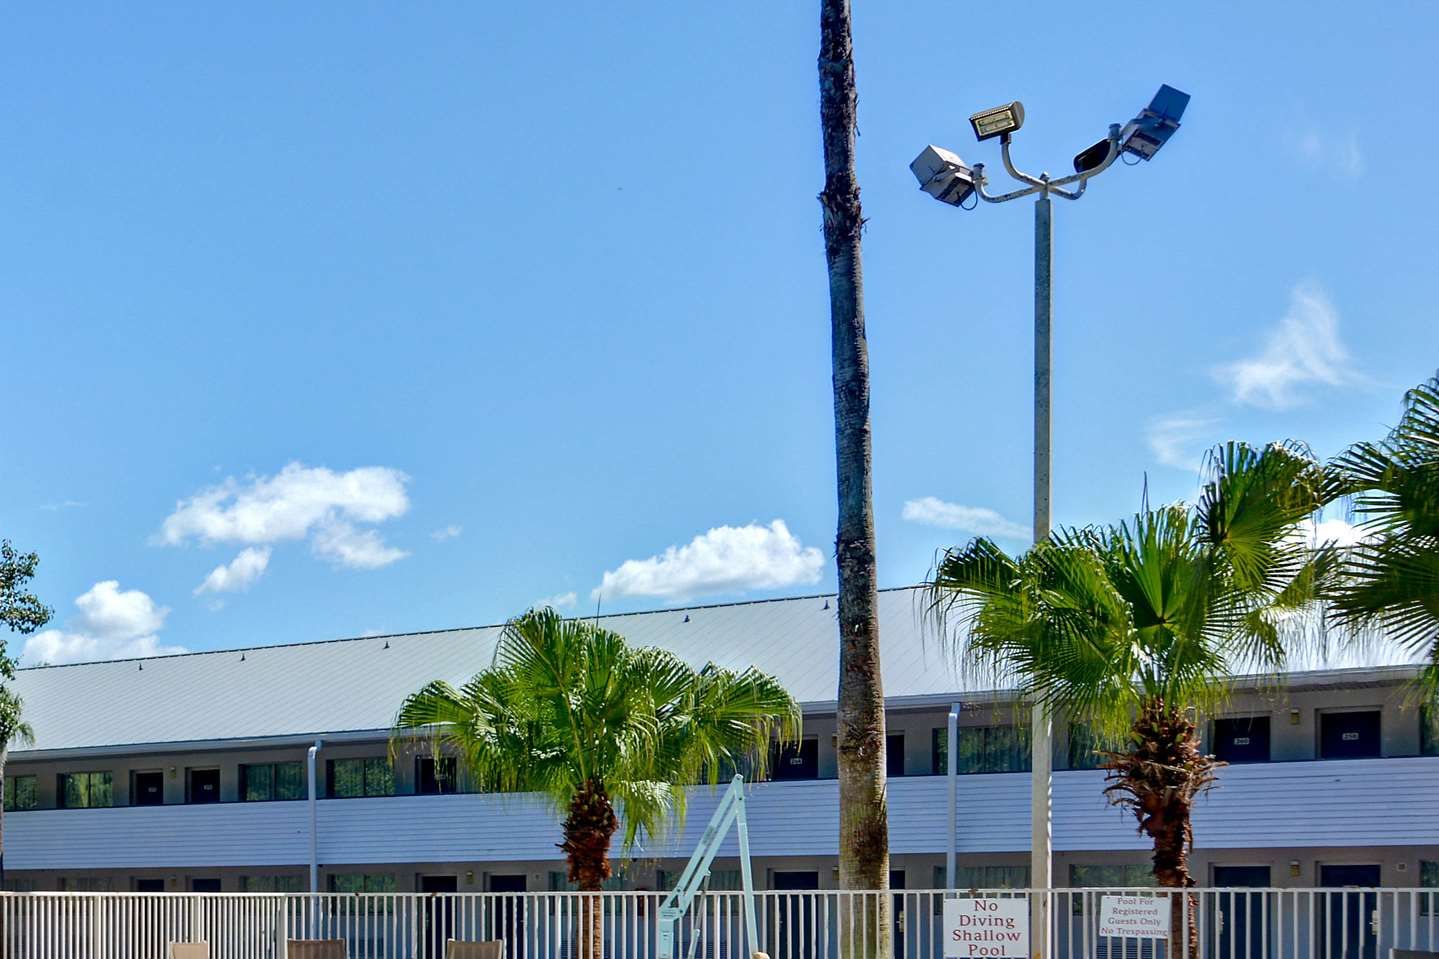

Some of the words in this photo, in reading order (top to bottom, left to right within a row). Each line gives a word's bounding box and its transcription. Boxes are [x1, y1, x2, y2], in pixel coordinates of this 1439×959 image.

[974, 899, 998, 912] No
[1117, 897, 1136, 905] Pool
[1139, 898, 1153, 906] For
[1112, 907, 1158, 916] Registered
[959, 914, 1015, 929] Diving
[1107, 917, 1137, 925] Guests
[1140, 917, 1161, 926] Only
[952, 929, 1021, 942] Shallow
[968, 943, 1006, 957] Pool
